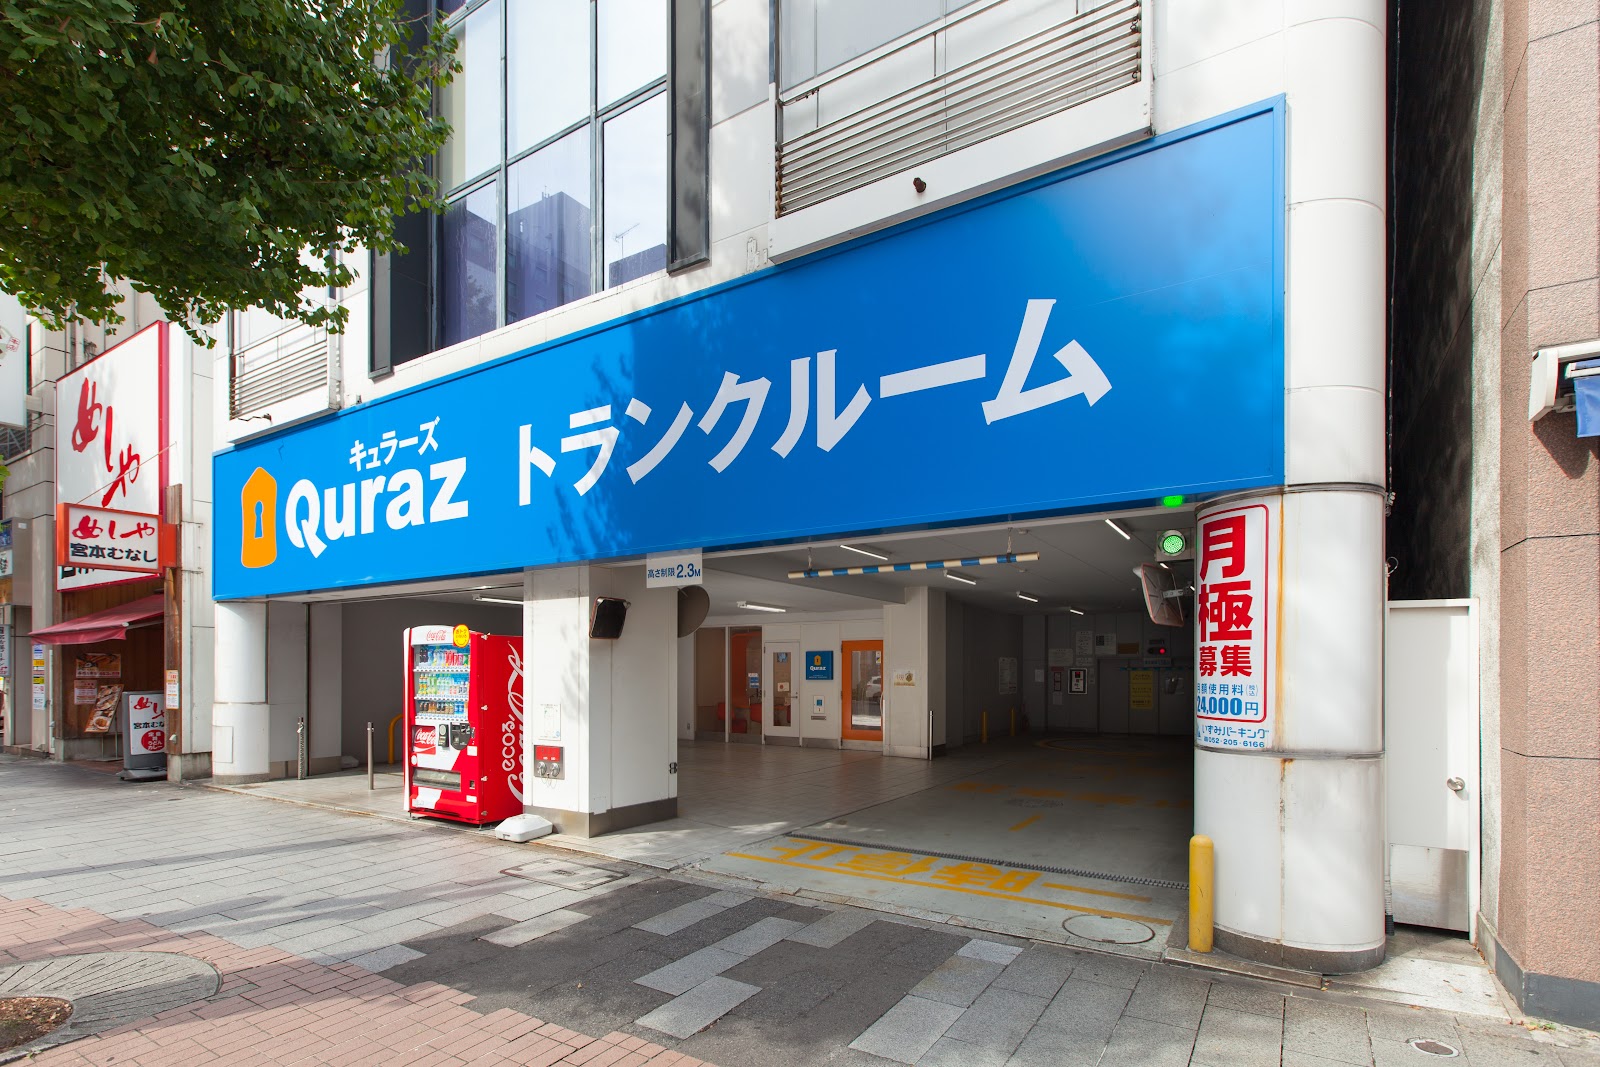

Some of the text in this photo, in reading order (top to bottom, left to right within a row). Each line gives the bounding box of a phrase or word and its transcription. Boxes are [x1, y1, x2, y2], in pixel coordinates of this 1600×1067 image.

[71, 377, 141, 508] めしや
[518, 298, 1113, 508] トランクルーム
[349, 415, 441, 472] キュラーズ
[71, 514, 156, 540] めしや
[285, 456, 469, 559] Quraz
[70, 542, 157, 563] 宮本むなし
[1198, 514, 1254, 642] 月極
[1199, 645, 1253, 677] 募集
